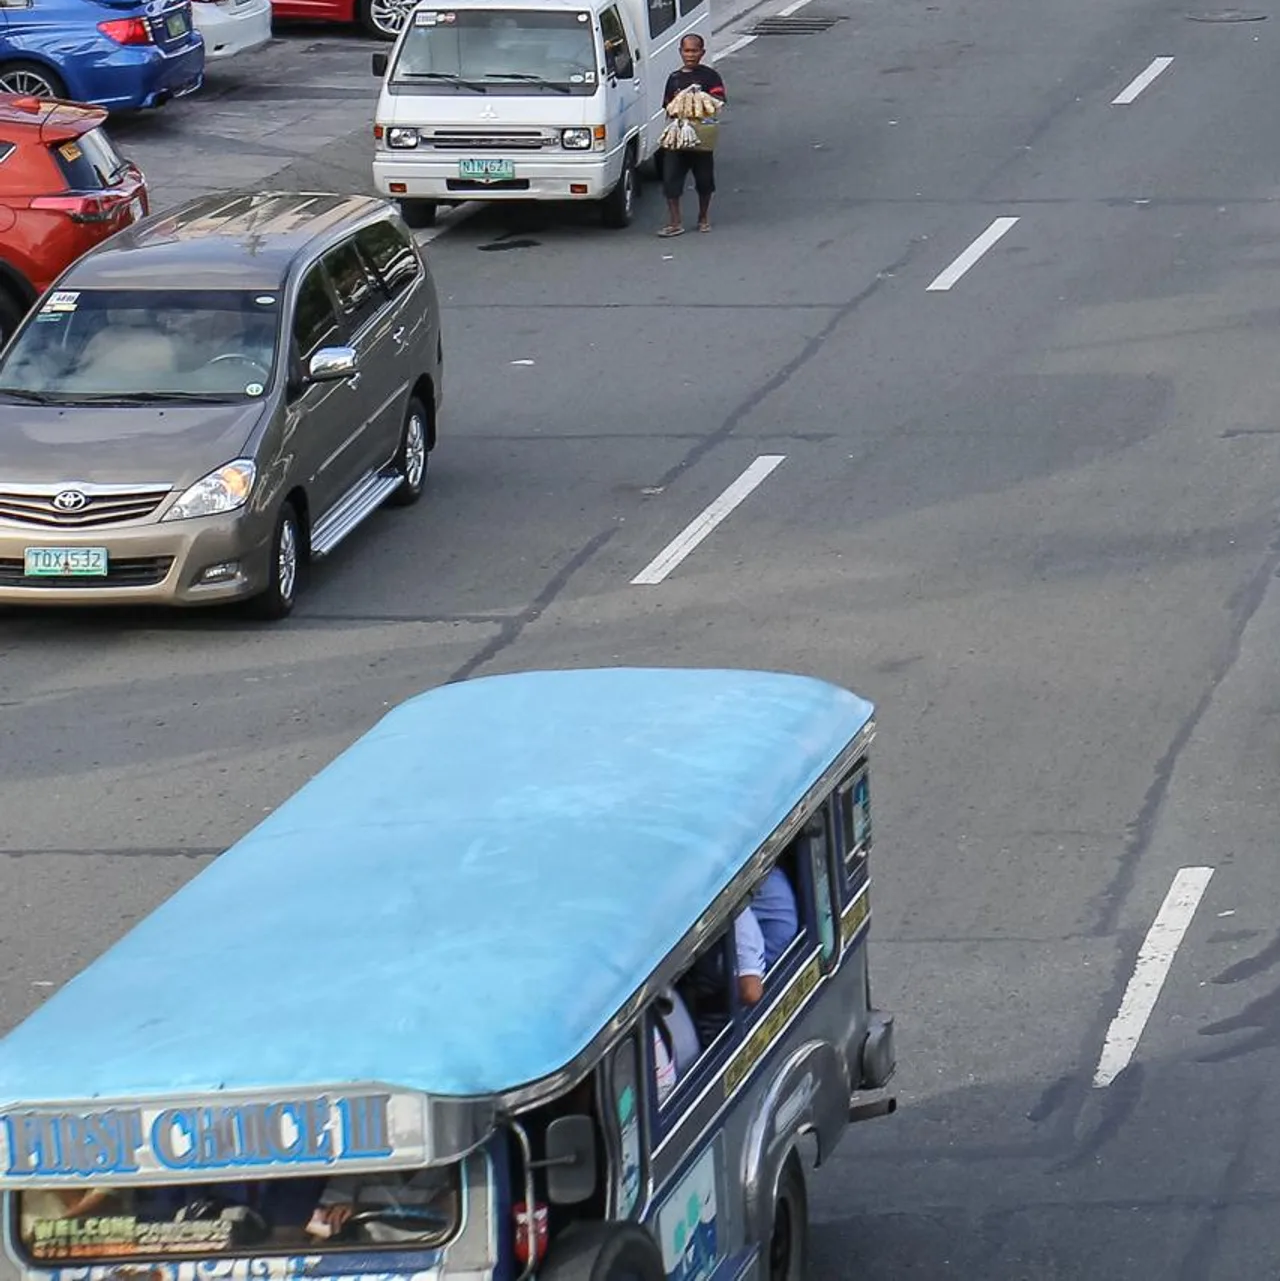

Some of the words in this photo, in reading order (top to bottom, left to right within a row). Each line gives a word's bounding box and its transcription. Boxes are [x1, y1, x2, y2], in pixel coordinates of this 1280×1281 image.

[71, 551, 101, 567] 532
[2, 1108, 143, 1179] FIRST
[151, 1095, 337, 1170] CHOICE
